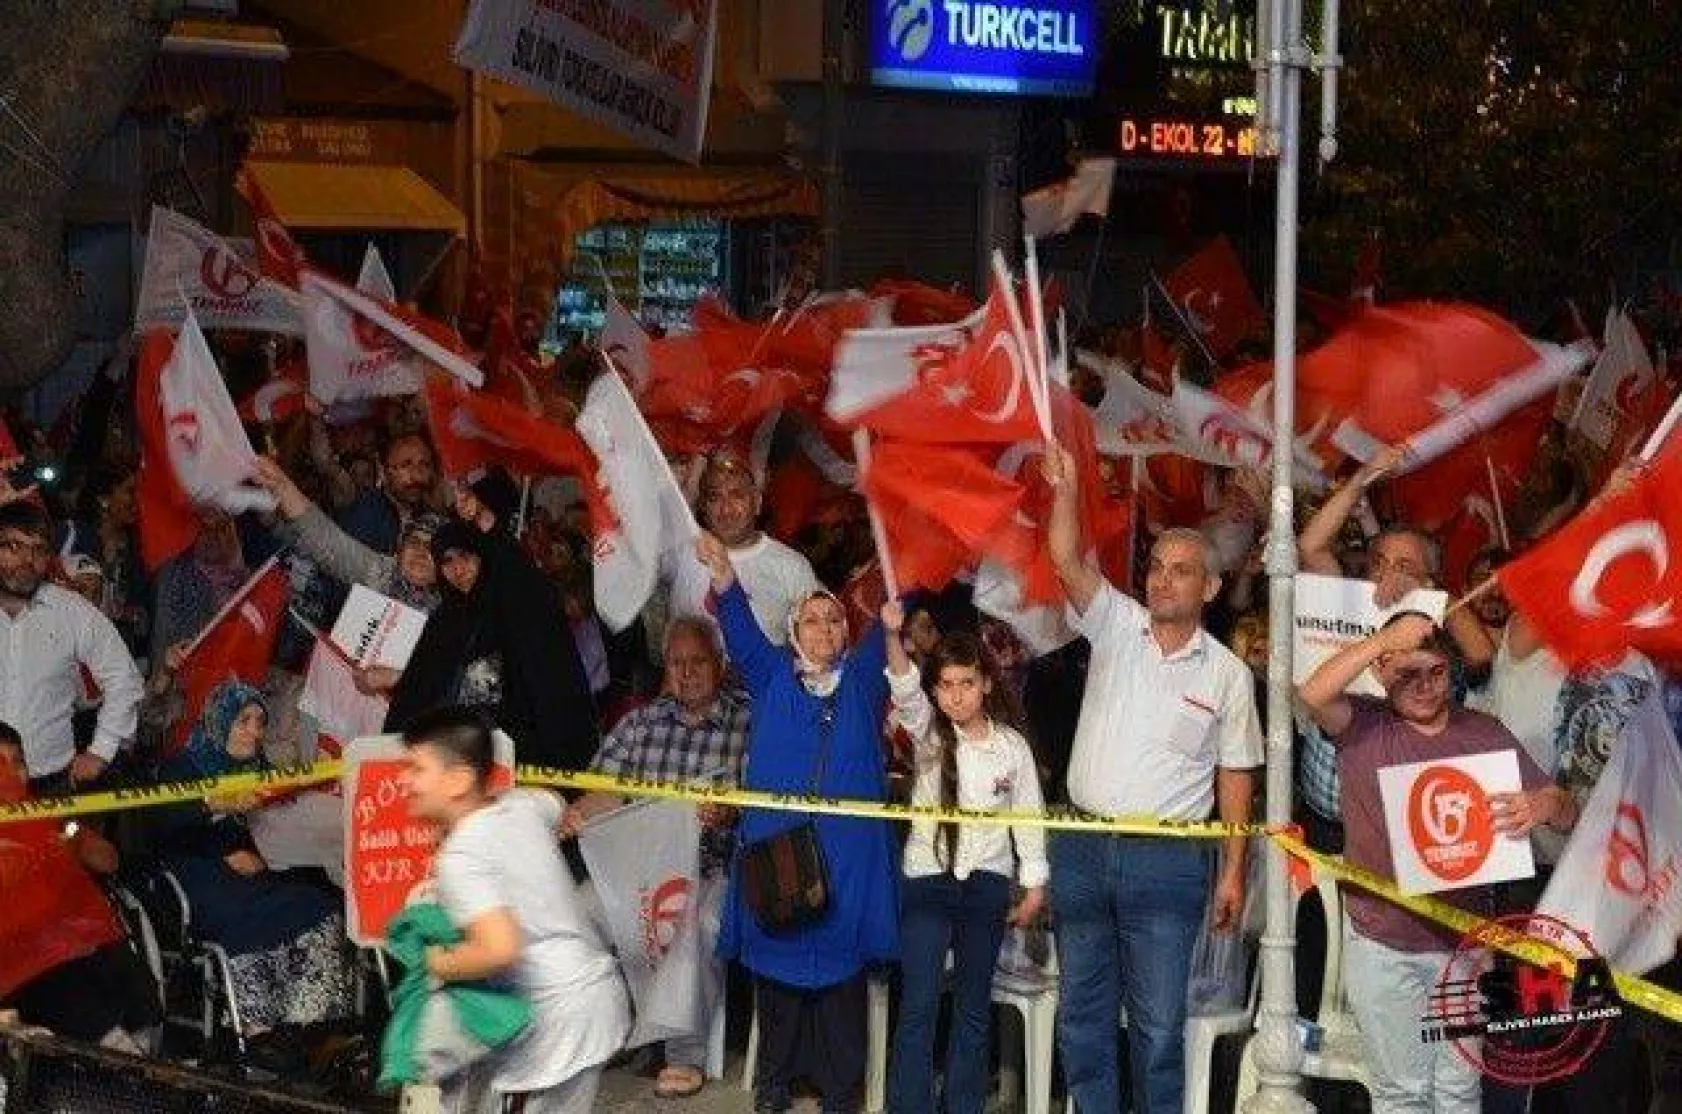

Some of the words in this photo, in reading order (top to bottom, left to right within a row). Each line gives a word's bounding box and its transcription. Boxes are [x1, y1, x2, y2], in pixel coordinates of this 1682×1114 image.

[943, 0, 1083, 55] TURKCELL
[1121, 120, 1136, 151] D
[1151, 122, 1199, 153] EKOL
